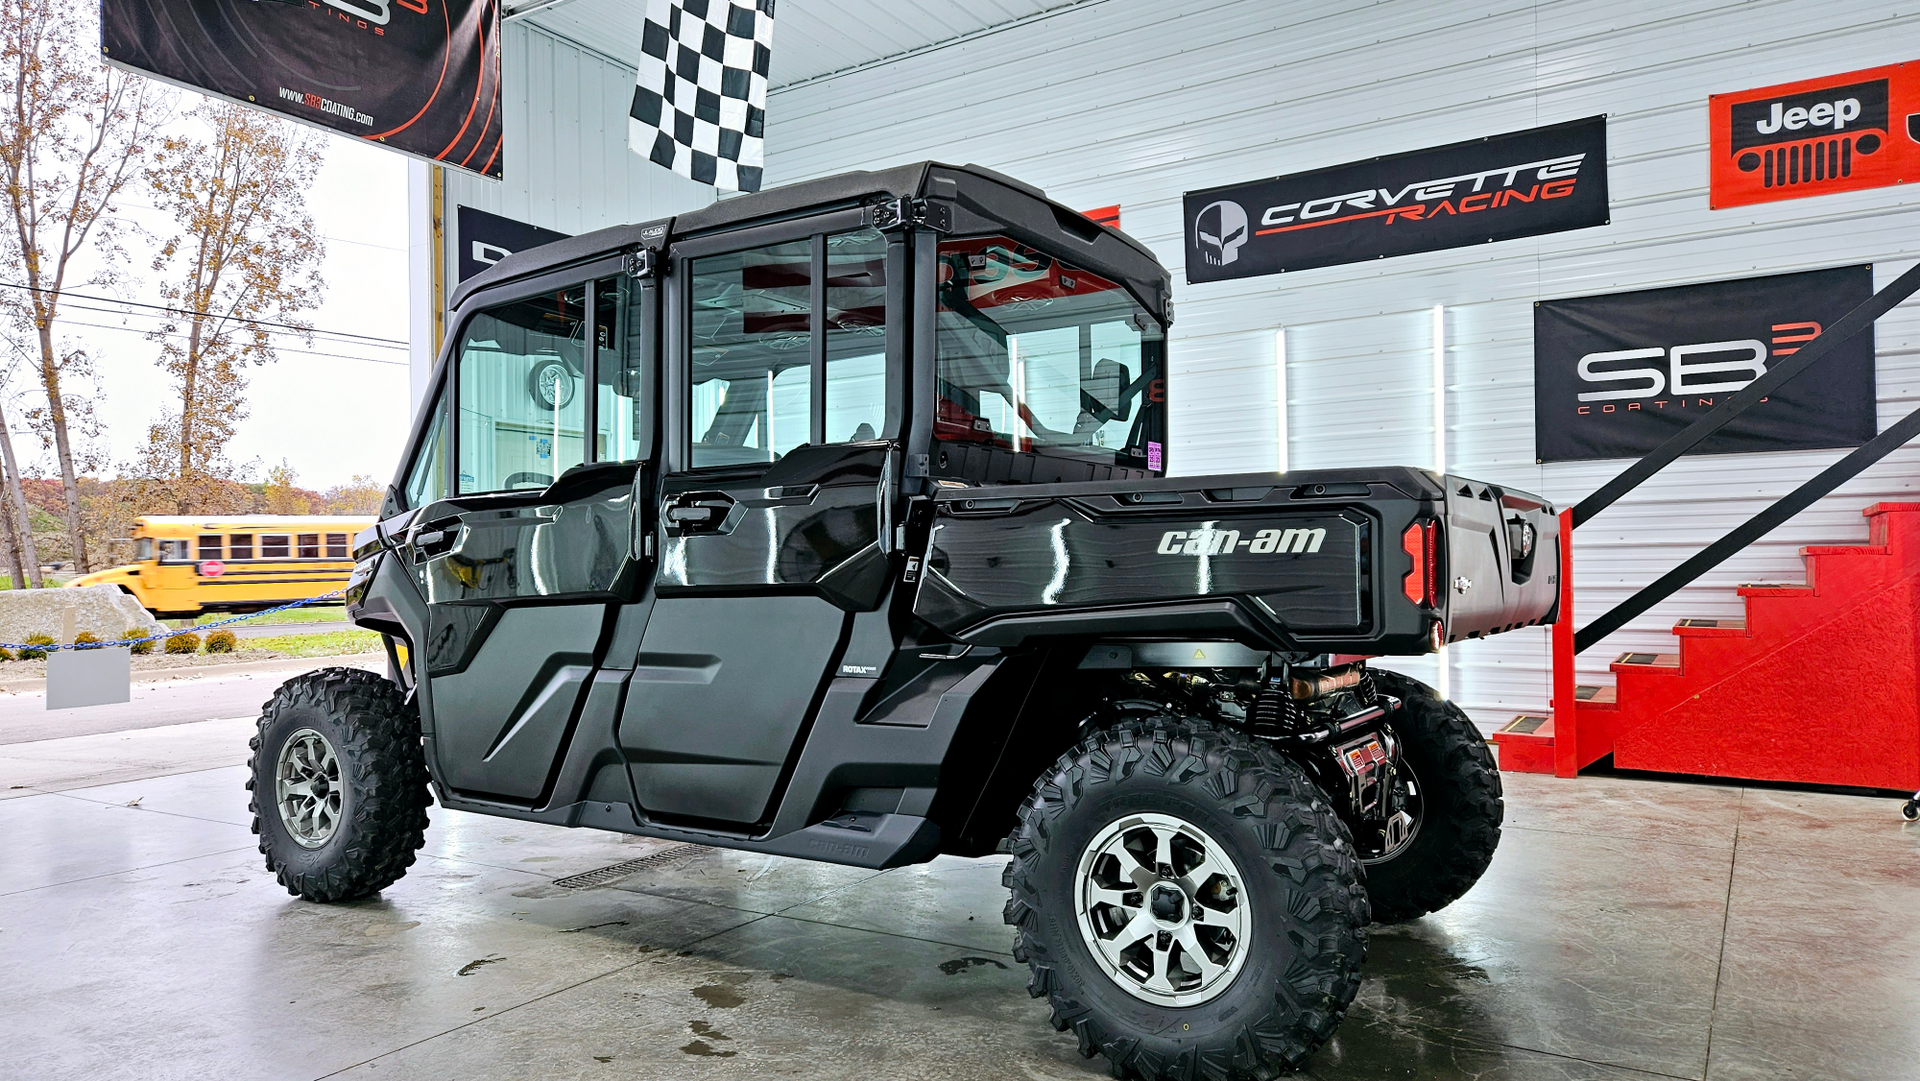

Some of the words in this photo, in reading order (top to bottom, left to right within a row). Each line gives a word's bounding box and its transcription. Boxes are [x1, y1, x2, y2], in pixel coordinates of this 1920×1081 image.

[308, 0, 385, 36] TINGS
[1756, 97, 1862, 135] Jeep
[1261, 152, 1587, 226] CORVETTE
[1384, 178, 1578, 225] RACING
[1577, 396, 1769, 415] COATIN
[1156, 527, 1327, 555] can-am
[842, 665, 867, 674] ROTAX
